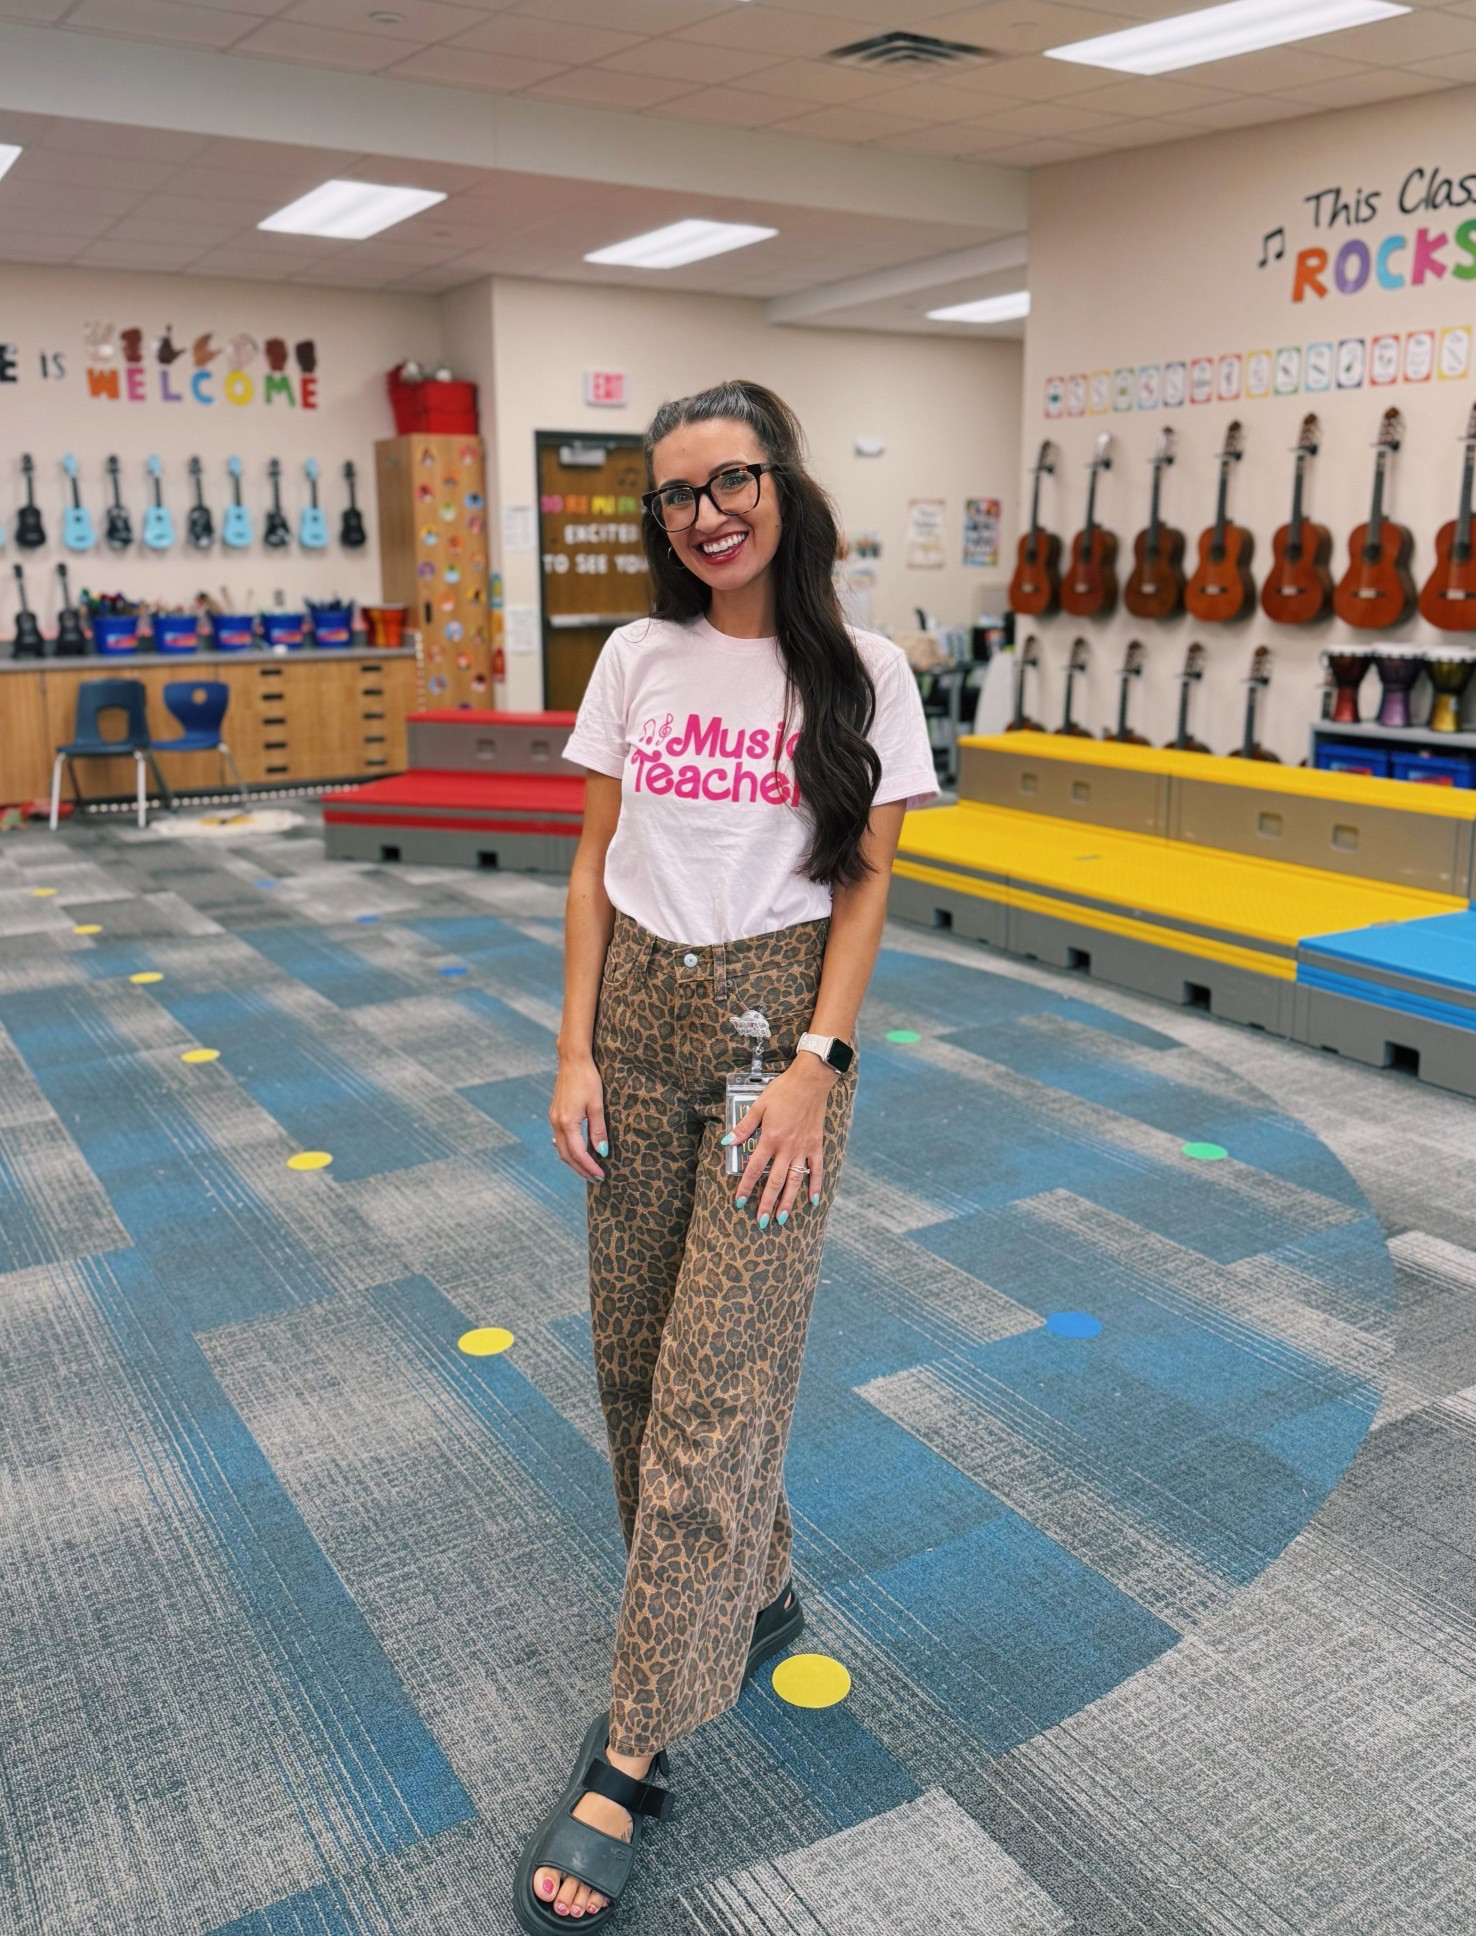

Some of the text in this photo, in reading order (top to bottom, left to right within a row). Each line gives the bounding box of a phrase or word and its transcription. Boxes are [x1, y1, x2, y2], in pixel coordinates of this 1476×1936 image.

[1304, 167, 1476, 228] This Clas
[1291, 218, 1476, 304] ROCKS
[40, 352, 67, 381] IS
[87, 366, 318, 410] WELCOME
[593, 371, 624, 401] EXIT
[542, 553, 570, 575] TO
[575, 553, 609, 575] SEE
[666, 714, 804, 760] Music
